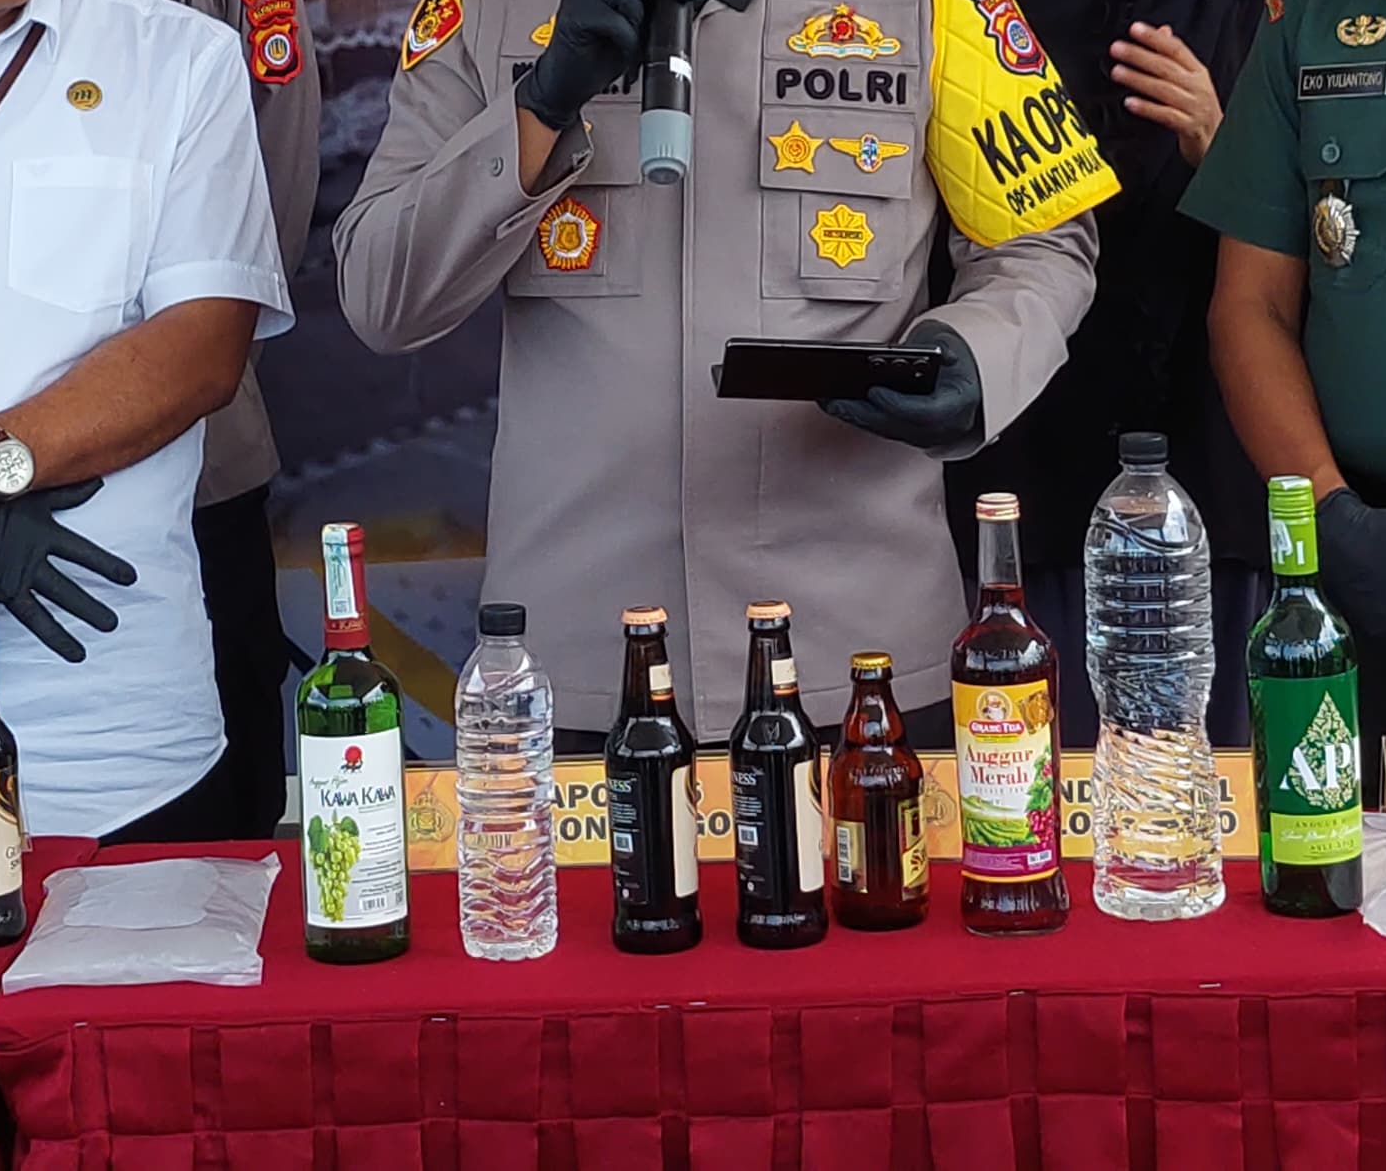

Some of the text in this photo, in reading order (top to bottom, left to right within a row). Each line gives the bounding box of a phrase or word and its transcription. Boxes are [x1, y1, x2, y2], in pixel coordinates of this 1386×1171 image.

[775, 67, 908, 105] POLRI
[965, 744, 1034, 768] Anggur
[1279, 736, 1361, 790] API
[970, 766, 1030, 785] Merah
[320, 785, 396, 807] KAWA KAWA
